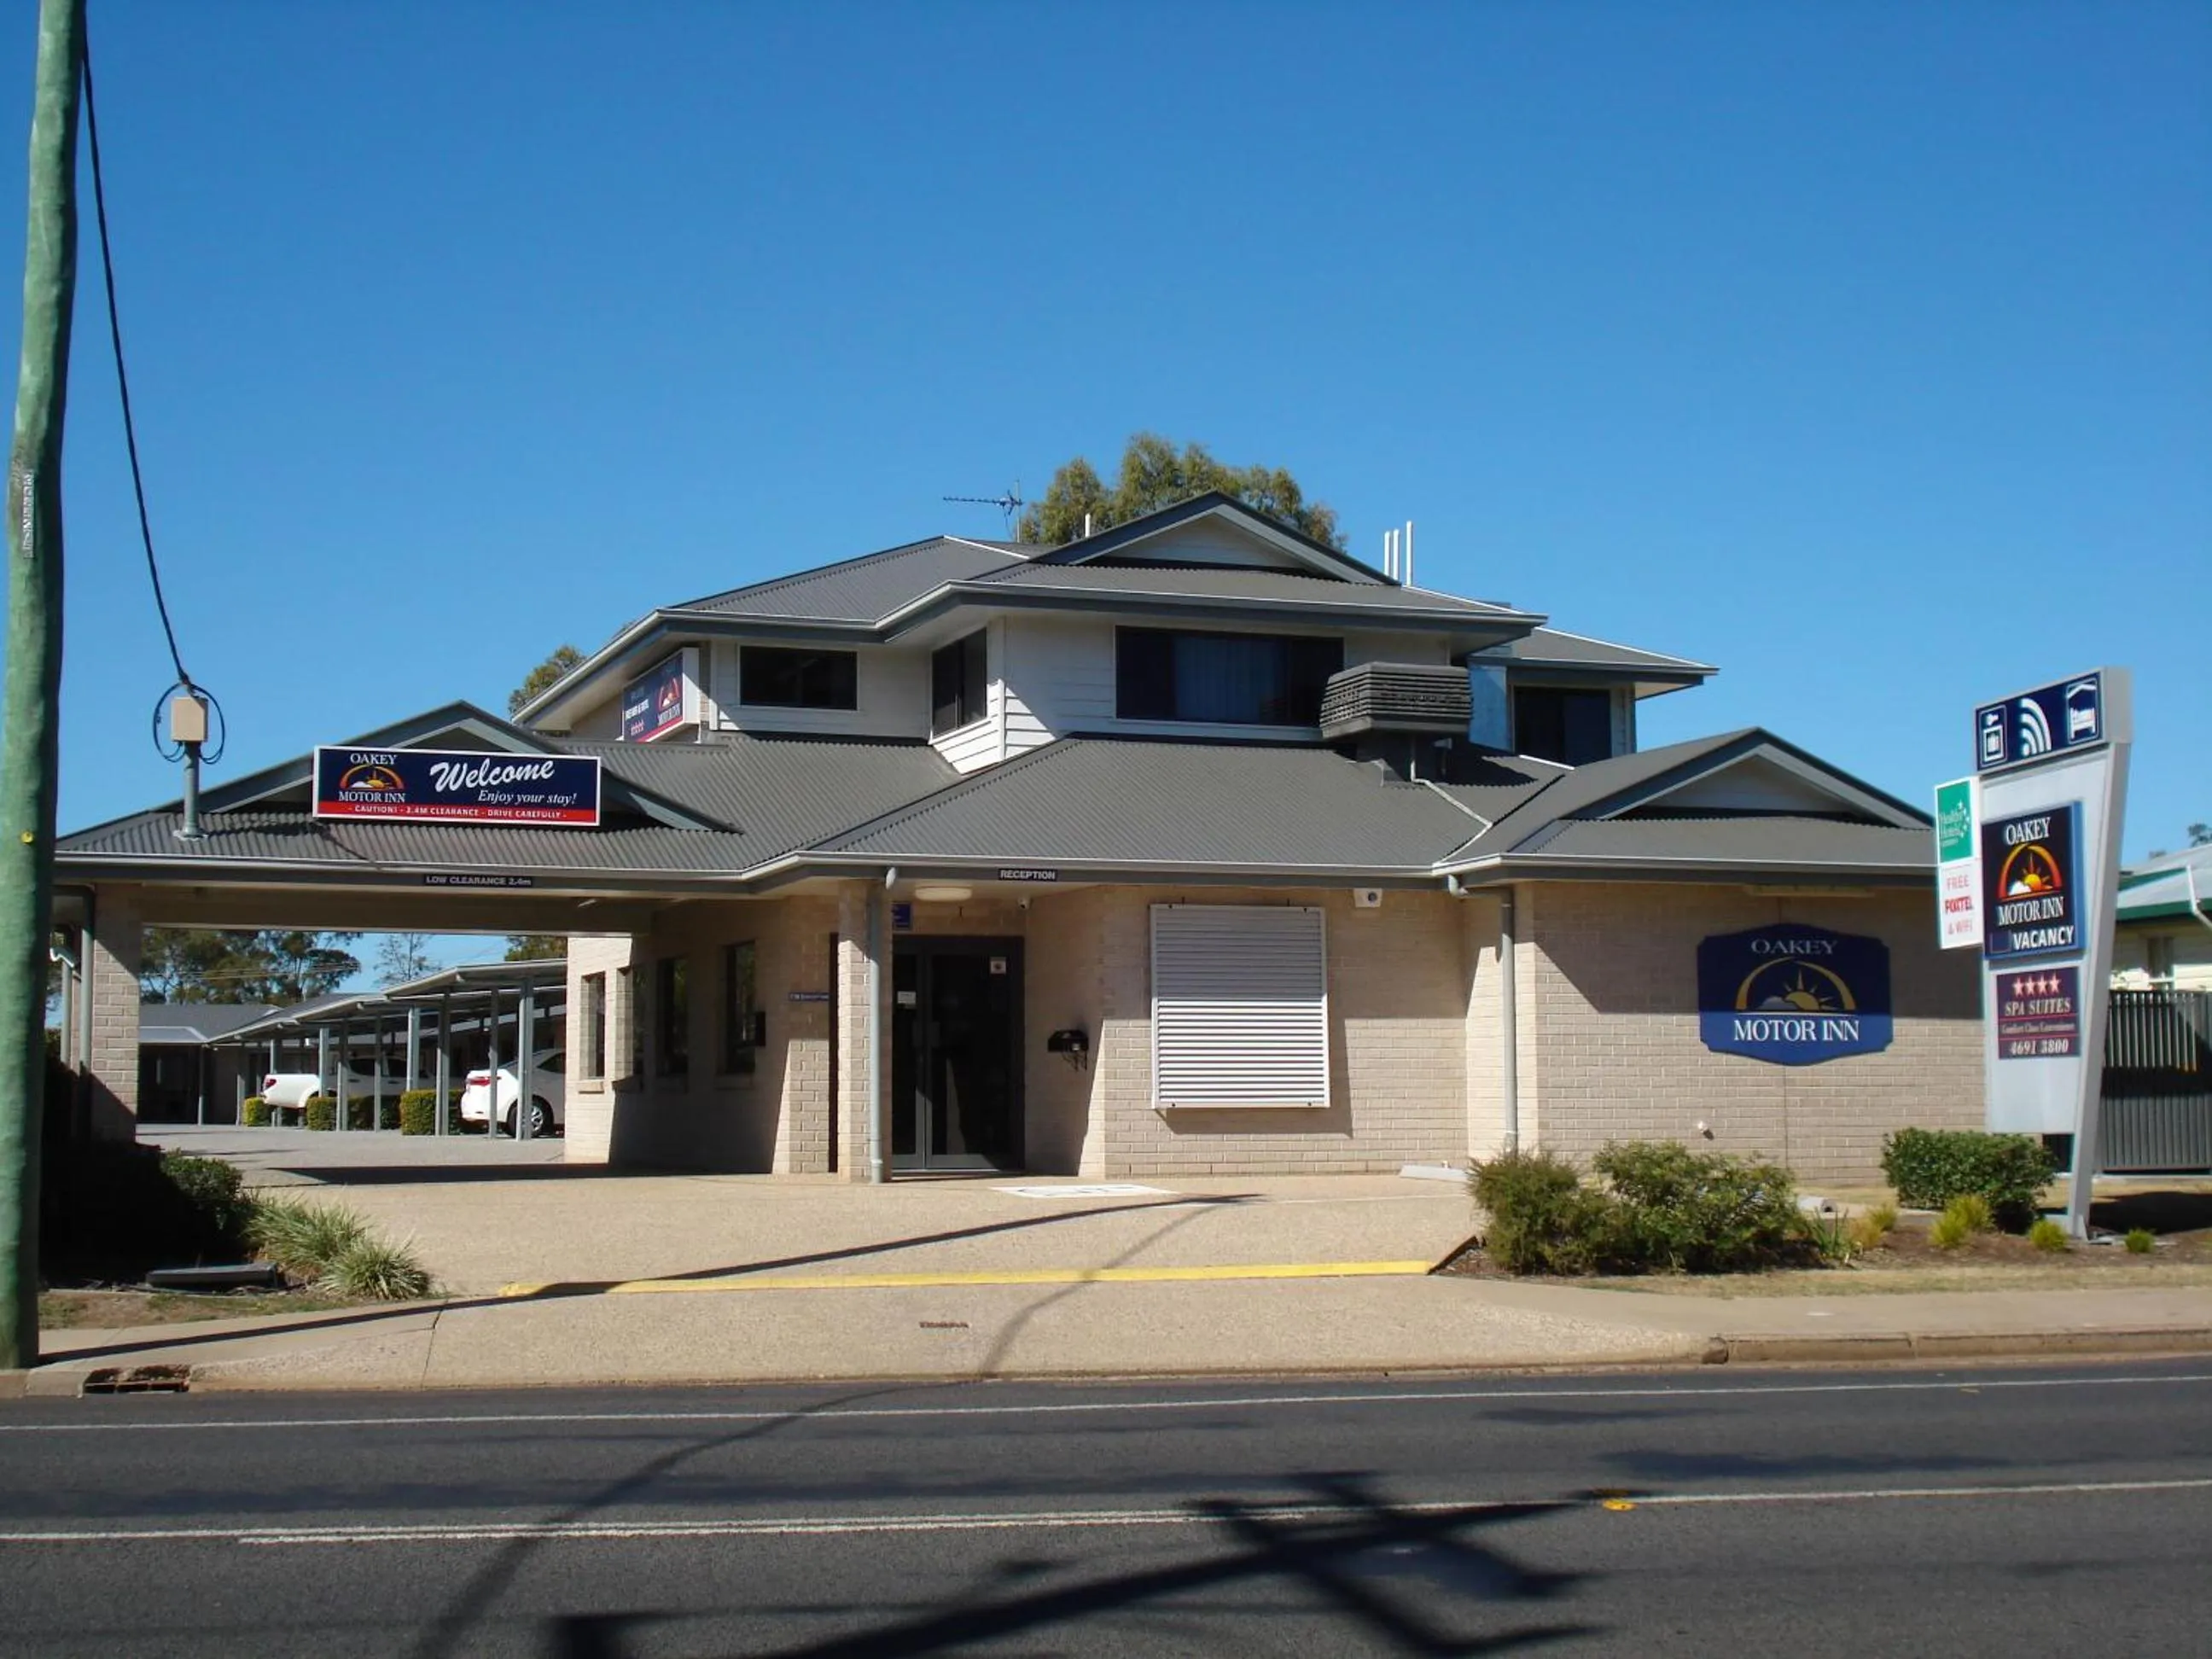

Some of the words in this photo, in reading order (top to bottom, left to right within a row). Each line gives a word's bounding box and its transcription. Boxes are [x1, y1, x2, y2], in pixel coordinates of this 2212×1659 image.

[350, 753, 398, 765] OAKEY
[430, 758, 555, 793] Welcome
[339, 791, 382, 802] MOTOR
[385, 793, 406, 803] INN
[478, 789, 514, 805] Enjoy
[515, 794, 544, 805] your
[547, 793, 577, 806] stay!
[430, 807, 479, 817] CLEARANCE
[515, 810, 562, 818] CAREFULLY
[2005, 817, 2052, 845] OAKEY
[427, 876, 446, 884] LOW
[449, 876, 507, 886] CLEARANCE
[1000, 870, 1056, 880] RECEPTION
[1947, 875, 1970, 891] FREE
[1997, 898, 2042, 926] MOTOR
[2042, 896, 2064, 919] INN
[2012, 924, 2075, 950] VACANCY
[1751, 938, 1837, 955] OAKEY
[2005, 1001, 2025, 1016] SPA
[2029, 997, 2071, 1015] SUITES
[1734, 1020, 1817, 1041] MOTOR
[1822, 1020, 1860, 1041] INN
[2011, 1040, 2037, 1055] 4691
